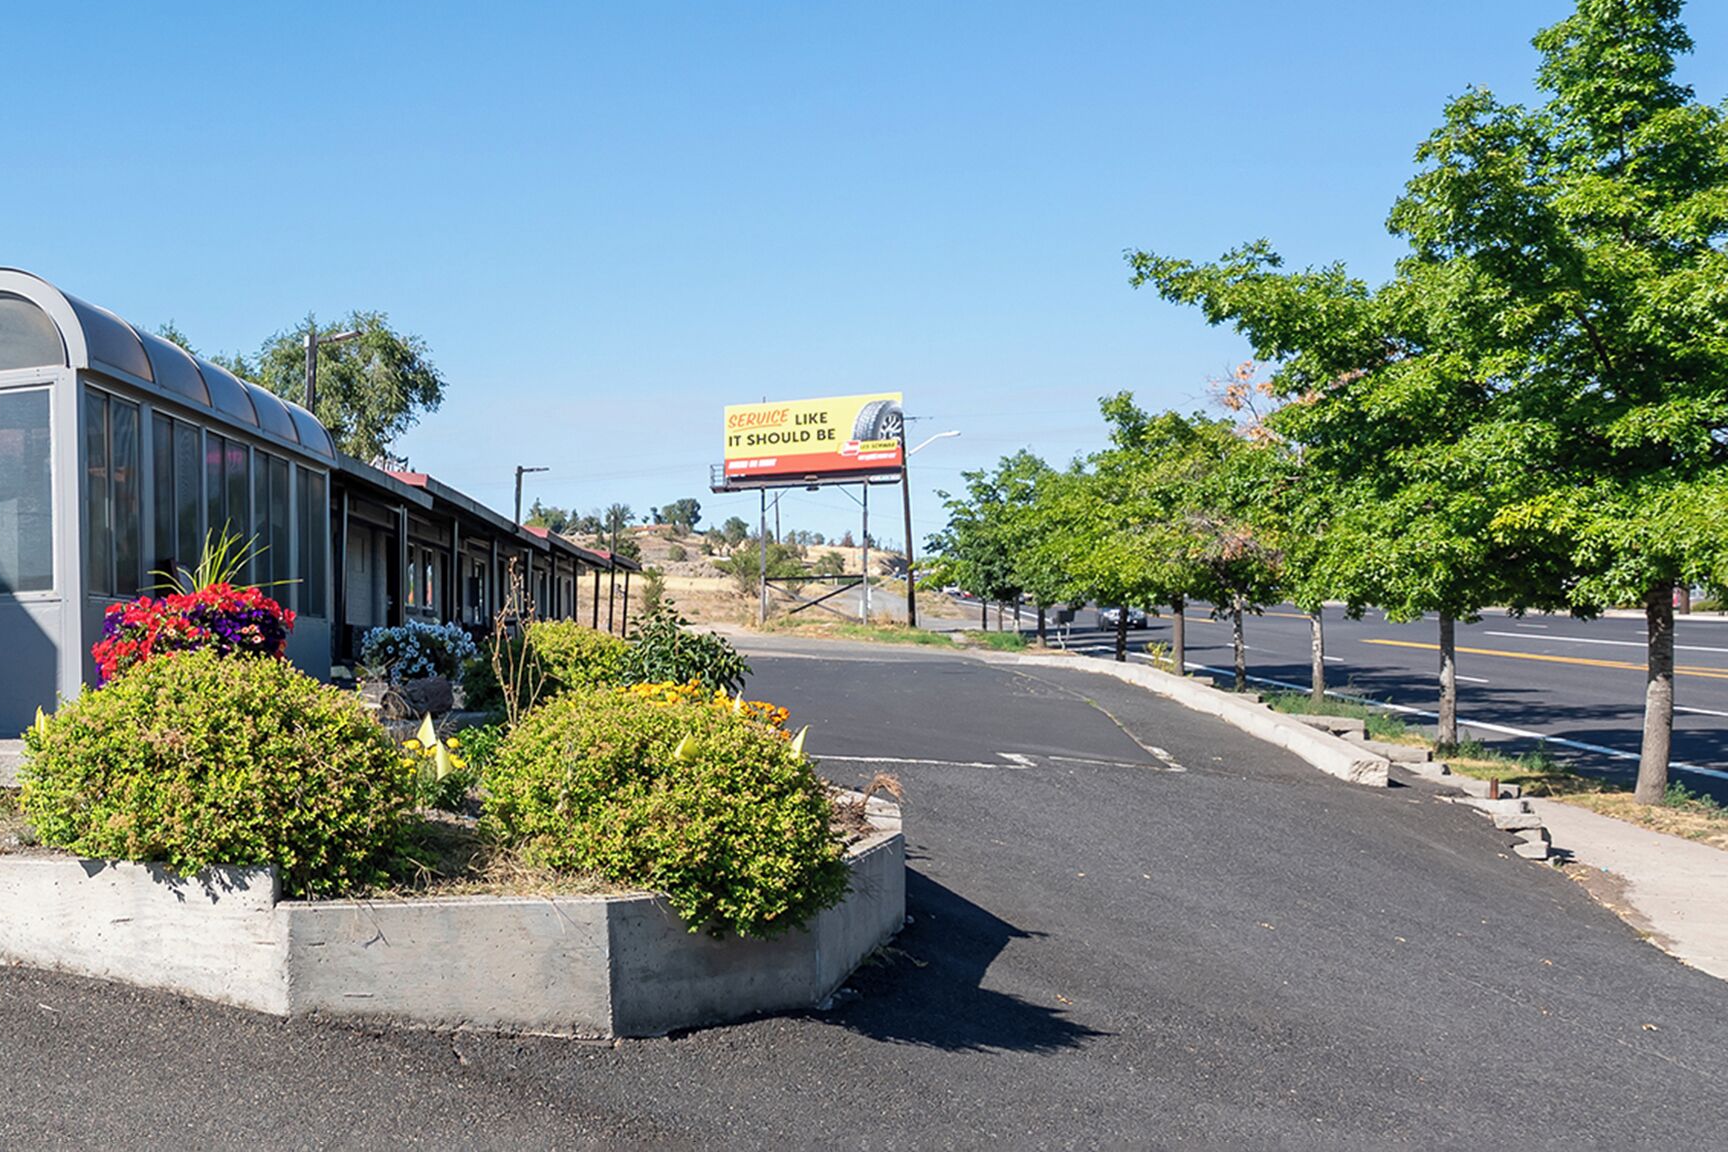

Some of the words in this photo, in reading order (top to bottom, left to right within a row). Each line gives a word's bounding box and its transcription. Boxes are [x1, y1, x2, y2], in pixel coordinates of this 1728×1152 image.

[727, 408, 790, 429] SERVICE
[795, 412, 828, 426] LIKE
[728, 435, 742, 447] IT
[747, 430, 811, 446] SHOULD
[816, 428, 836, 441] BE
